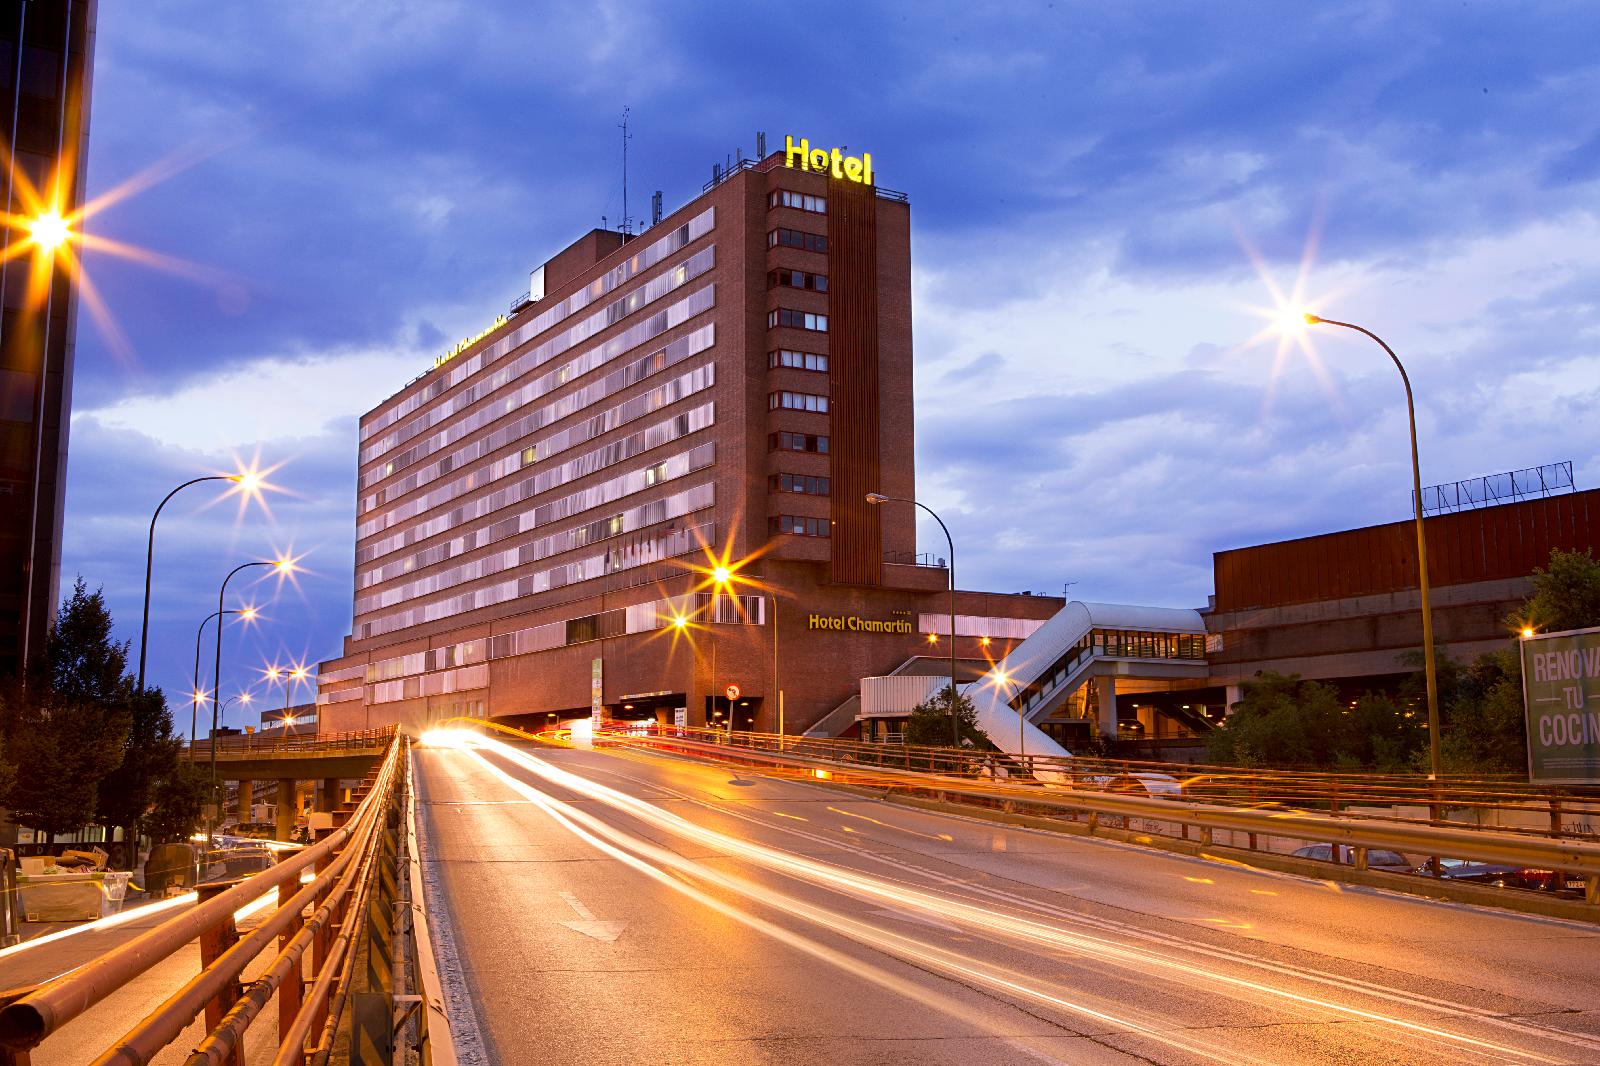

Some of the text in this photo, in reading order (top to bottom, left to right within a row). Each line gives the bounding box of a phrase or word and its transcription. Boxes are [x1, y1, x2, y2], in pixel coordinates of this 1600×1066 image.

[785, 135, 872, 185] Hotel
[809, 614, 845, 630] Hotel
[1562, 686, 1584, 710] TU
